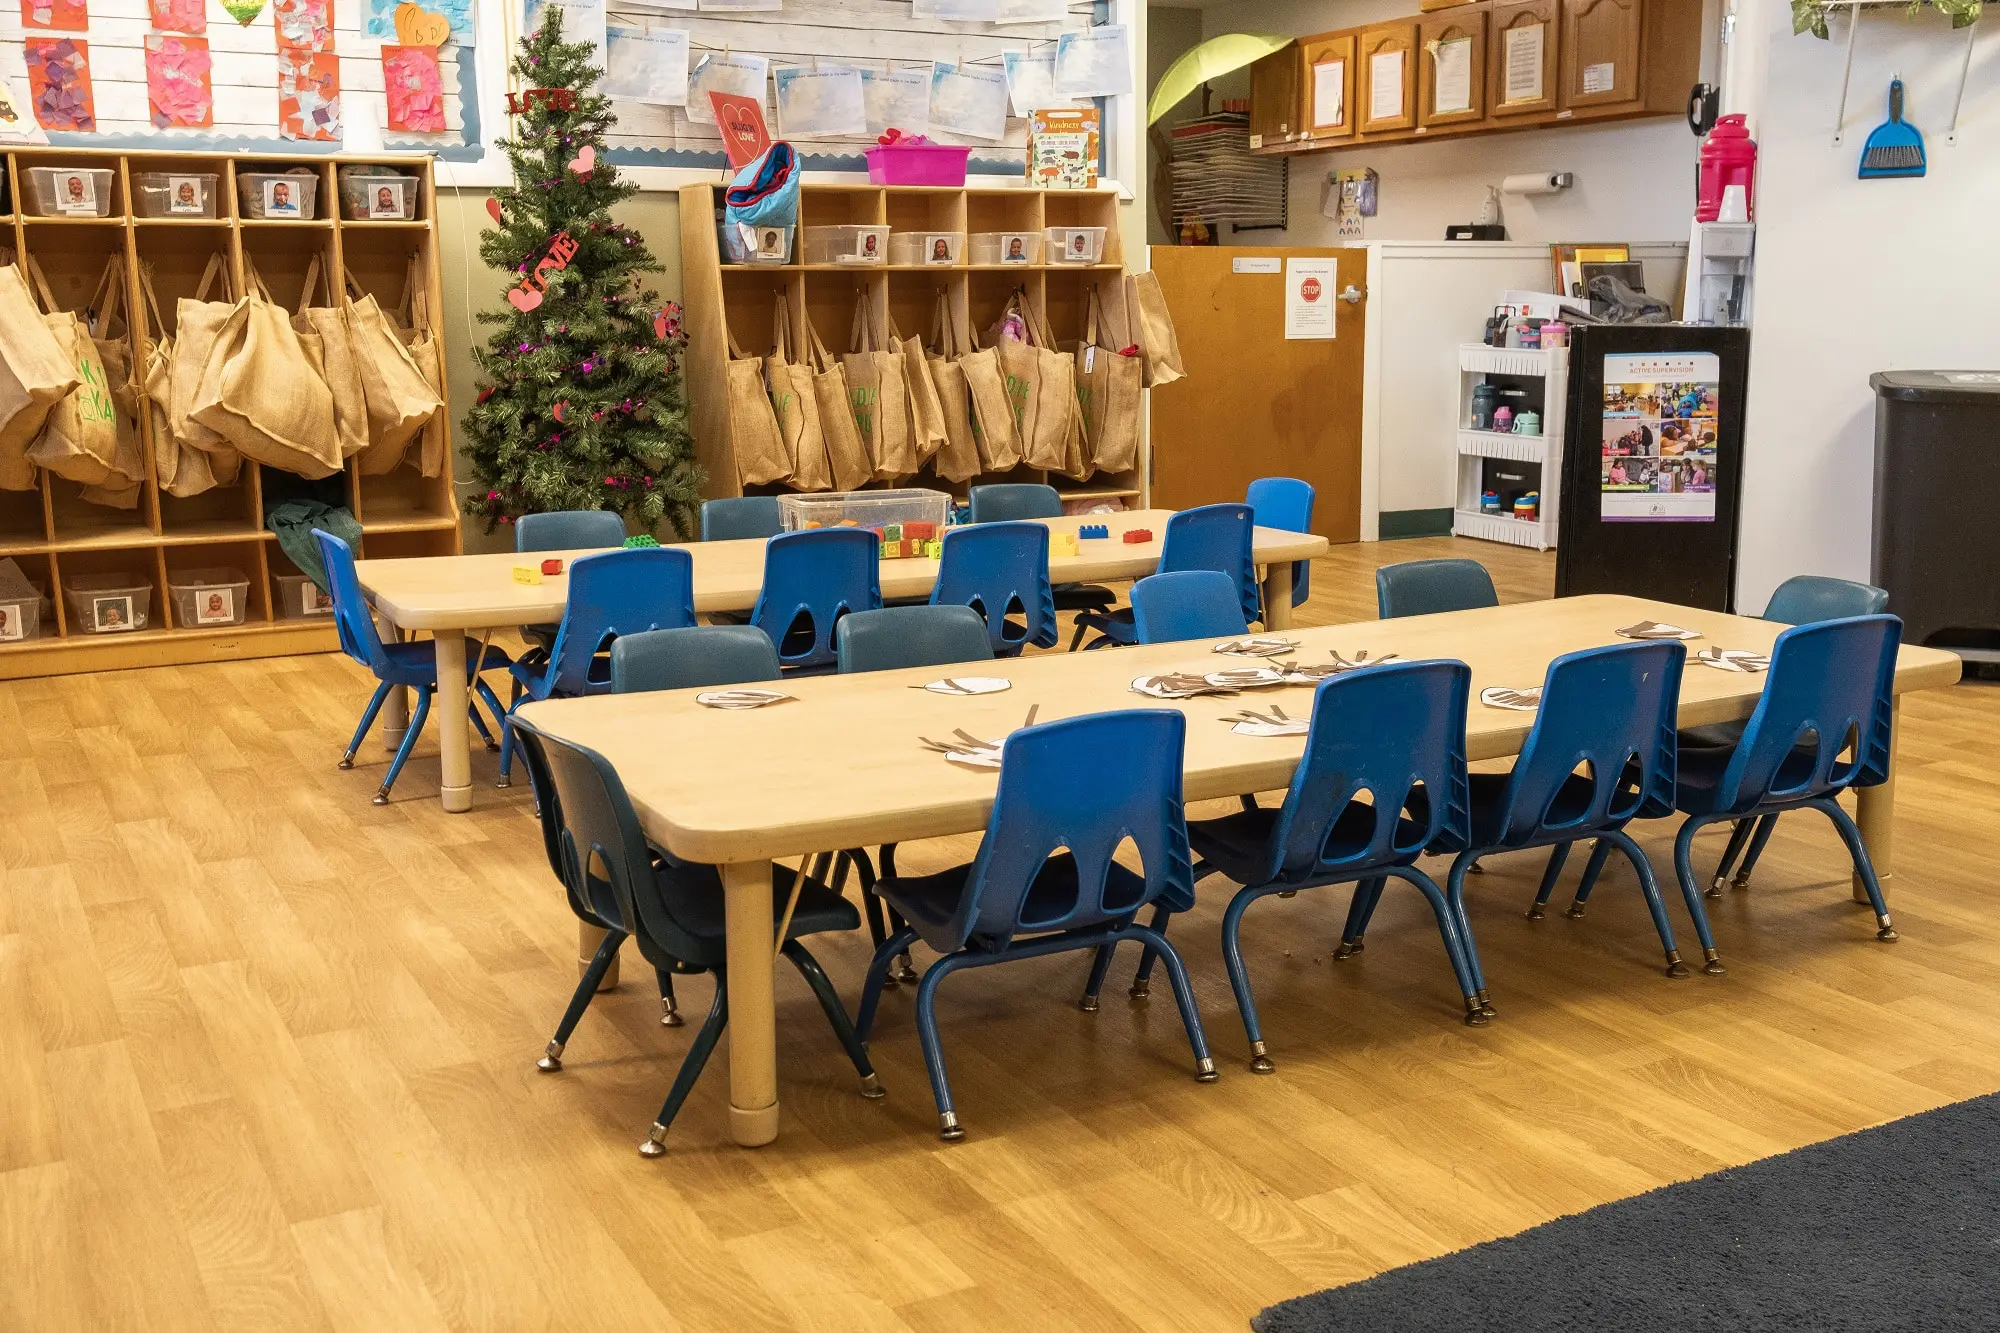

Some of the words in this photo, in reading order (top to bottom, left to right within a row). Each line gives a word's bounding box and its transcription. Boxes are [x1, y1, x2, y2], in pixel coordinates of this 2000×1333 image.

[505, 88, 580, 115] LOVE
[737, 131, 756, 142] LOVE
[1303, 285, 1320, 295] STOP
